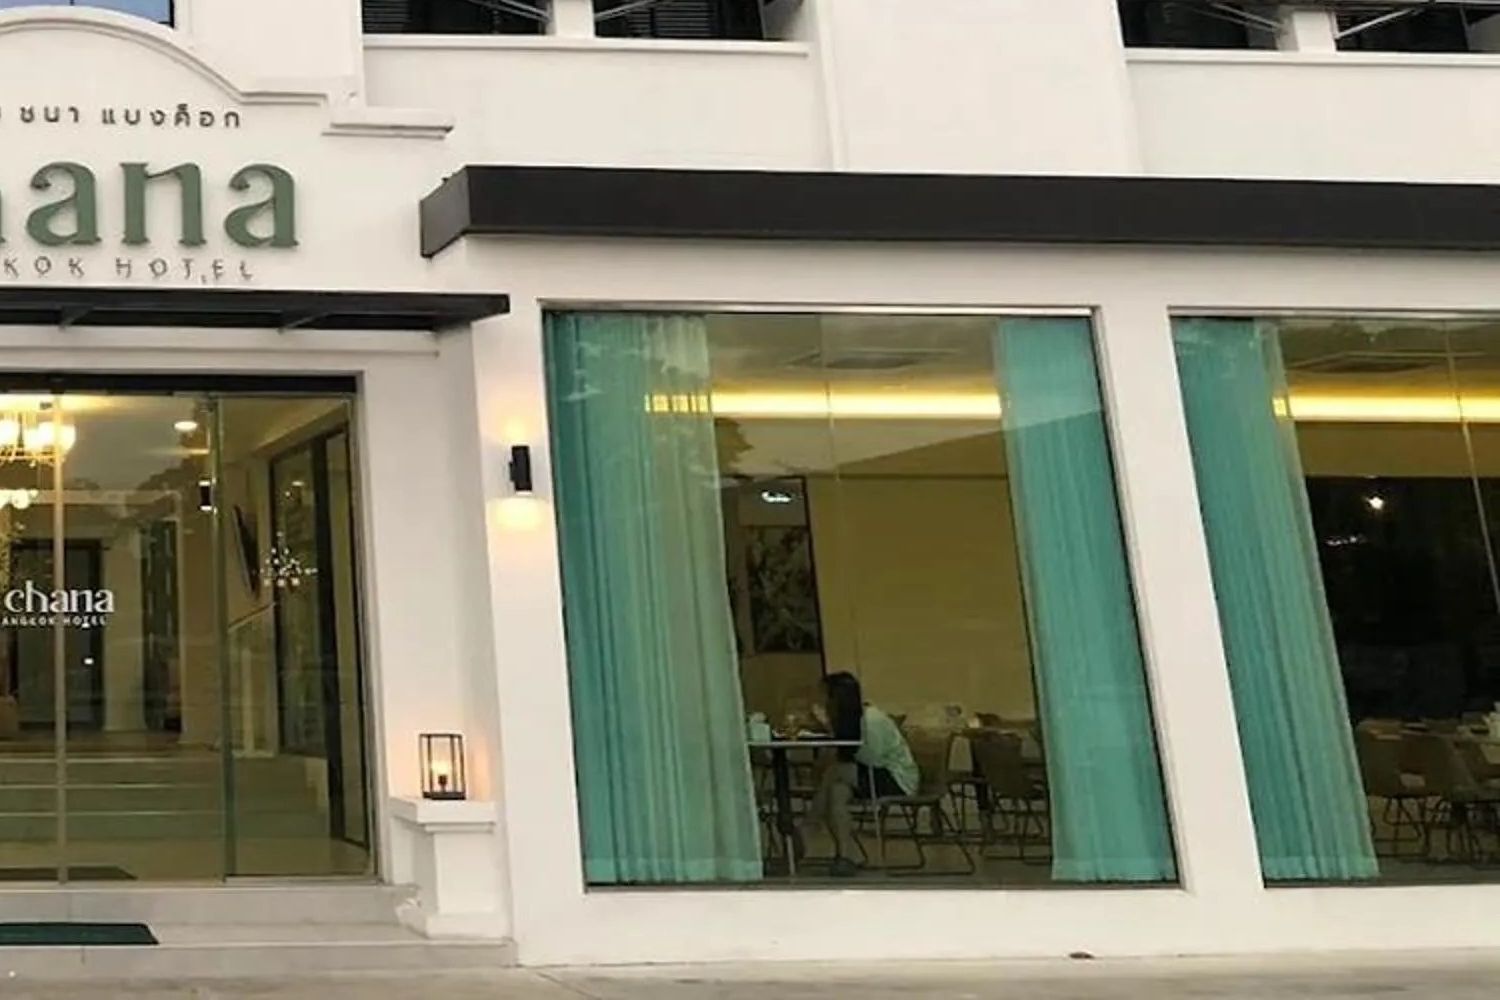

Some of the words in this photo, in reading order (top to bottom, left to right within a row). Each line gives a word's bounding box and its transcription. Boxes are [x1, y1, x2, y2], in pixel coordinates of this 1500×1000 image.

[20, 105, 80, 124] ชนา
[102, 103, 240, 128] แบงค็อก
[115, 257, 254, 282] HOTEL
[4, 580, 115, 613] chana
[63, 616, 108, 628] HOTEL
